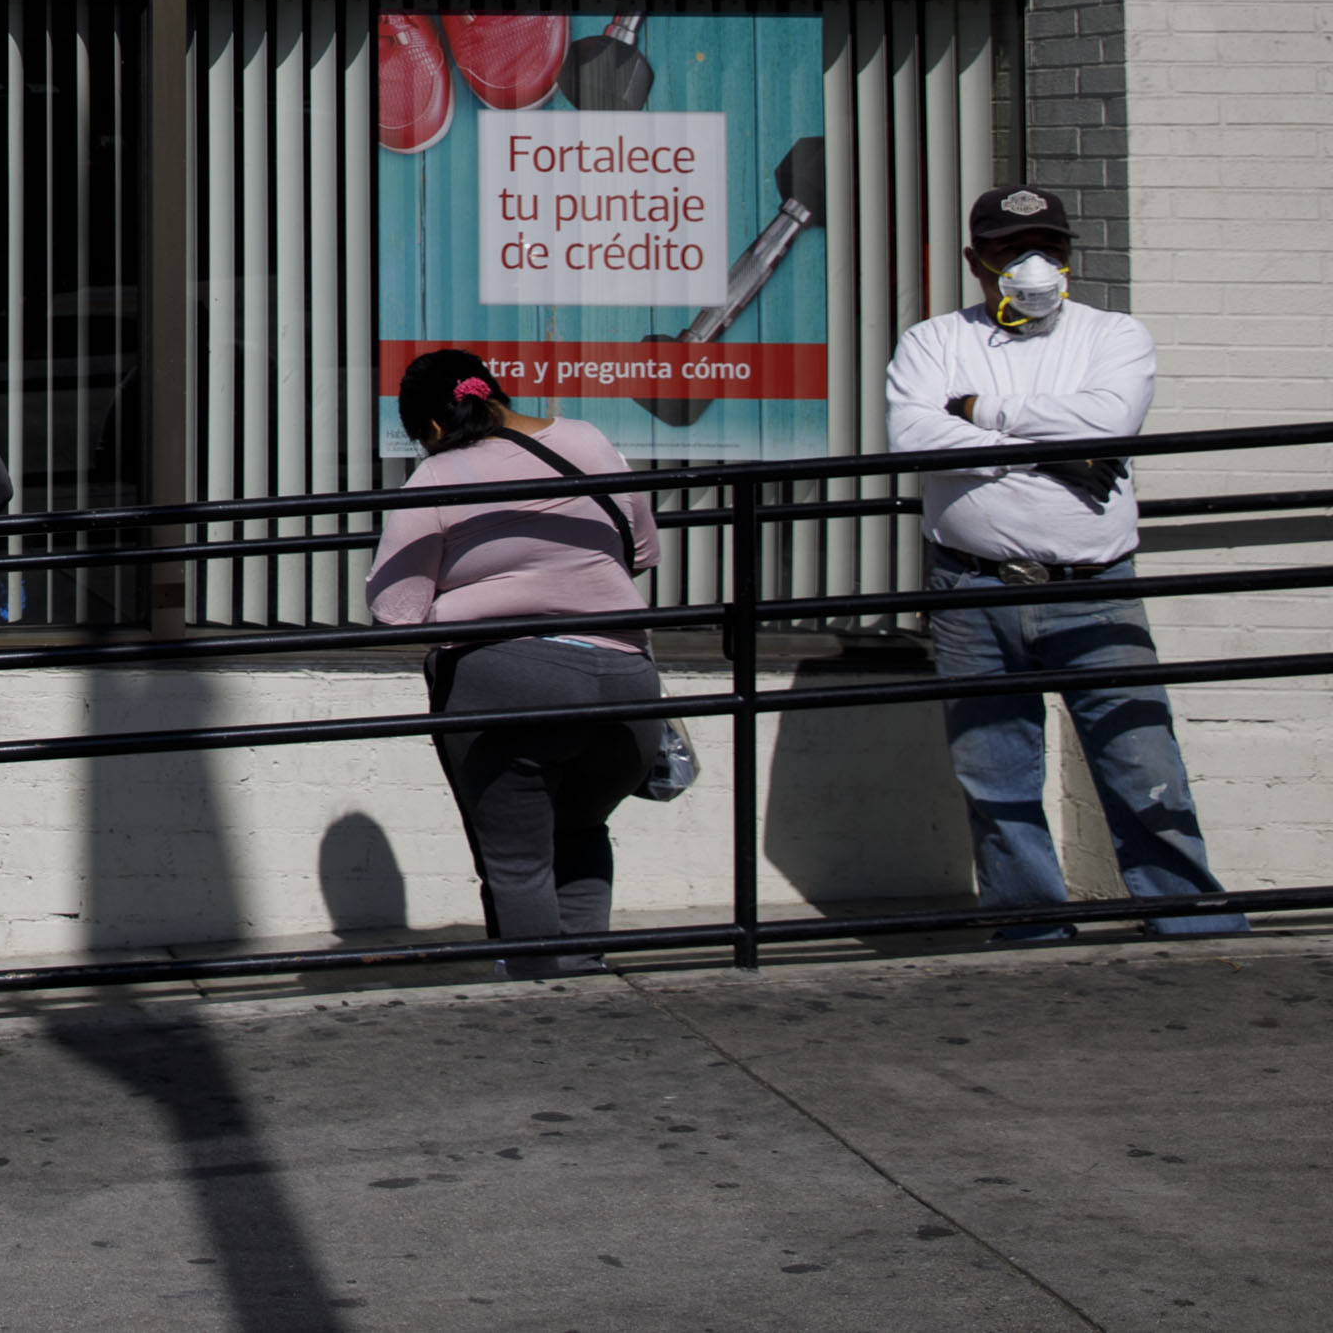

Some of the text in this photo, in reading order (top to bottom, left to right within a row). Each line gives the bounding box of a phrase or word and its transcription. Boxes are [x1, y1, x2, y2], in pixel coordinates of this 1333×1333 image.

[509, 134, 695, 174] Fortalece
[499, 186, 705, 232] tu puntaje
[500, 232, 704, 272] de crédito
[533, 361, 550, 384] y
[557, 358, 672, 385] pregunta
[681, 356, 751, 380] cómo
